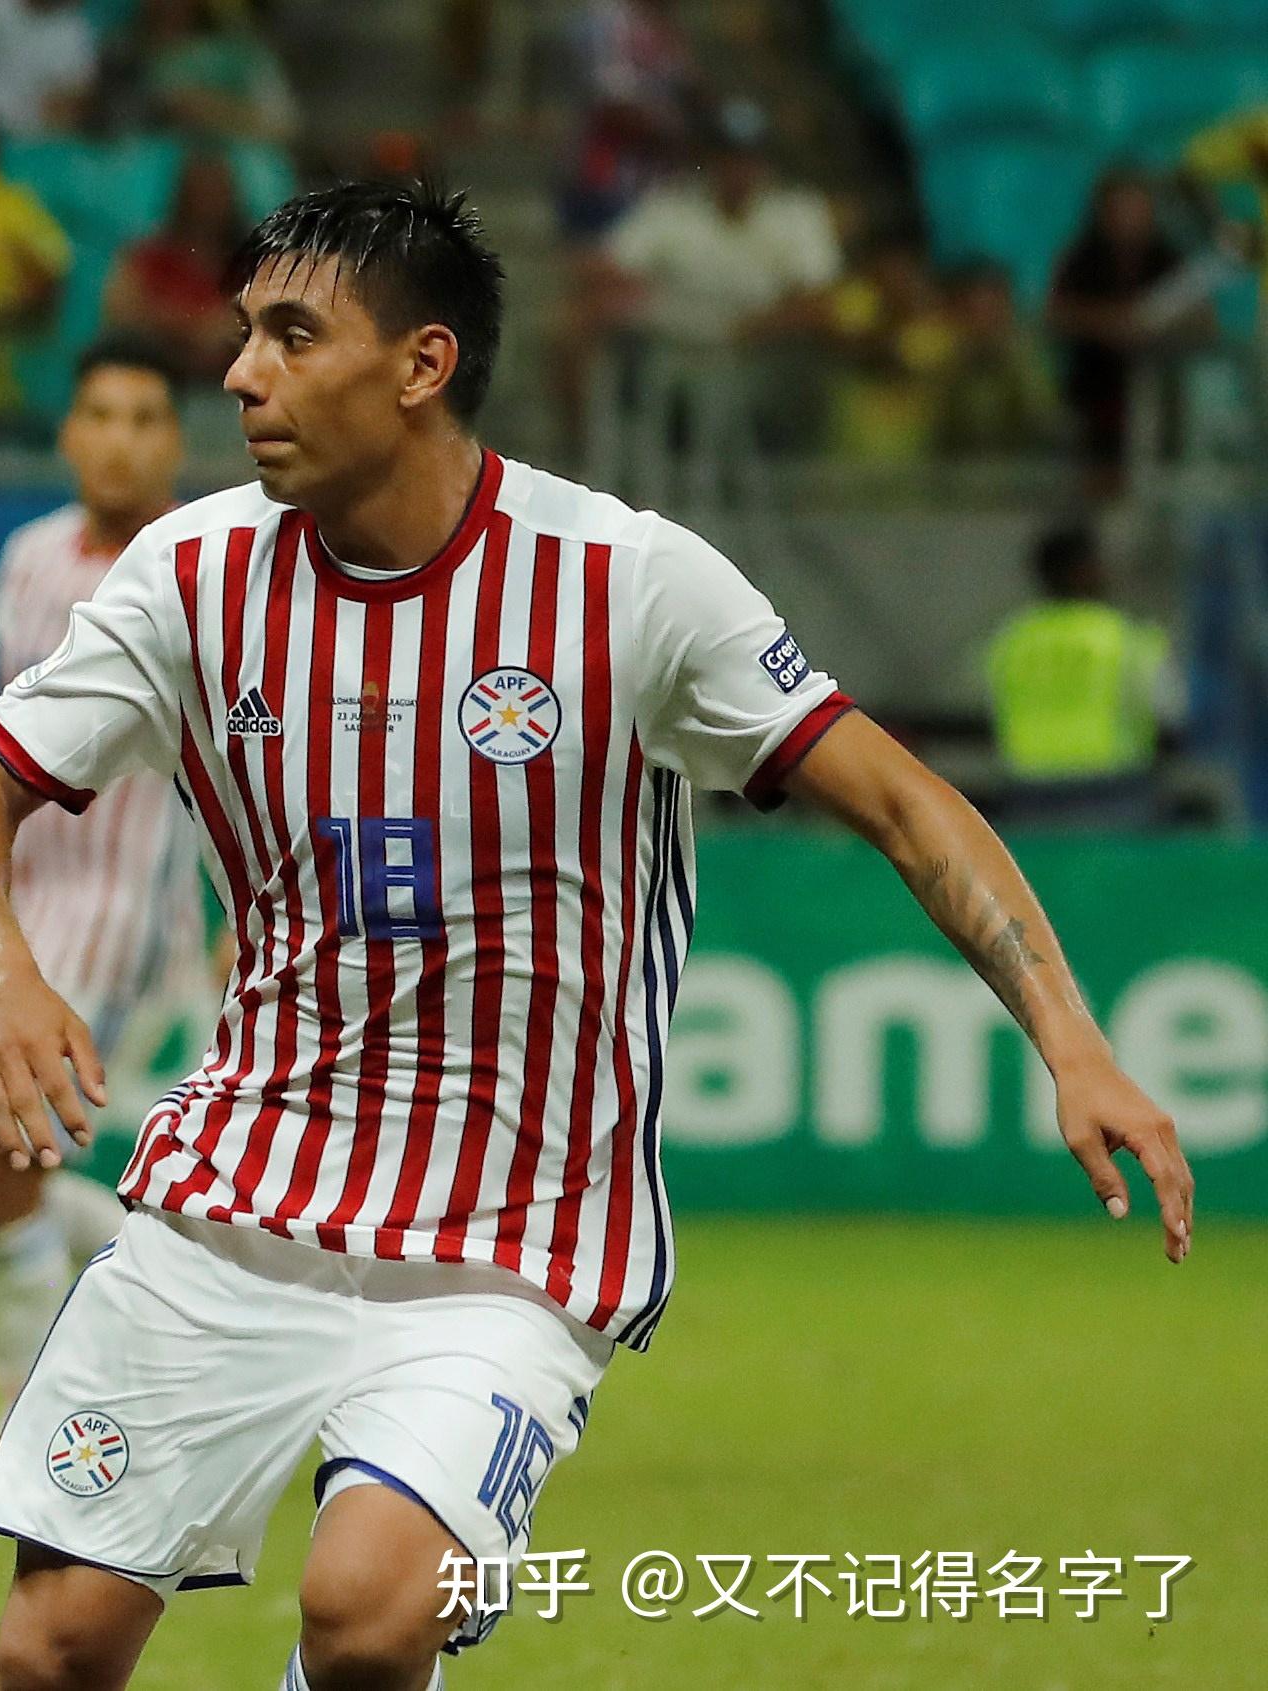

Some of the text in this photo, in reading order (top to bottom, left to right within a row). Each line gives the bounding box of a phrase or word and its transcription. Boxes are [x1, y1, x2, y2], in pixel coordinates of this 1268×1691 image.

[494, 676, 528, 690] APF
[227, 715, 279, 734] adidas
[485, 745, 532, 759] PARAGUAY
[316, 817, 440, 941] 18
[82, 1416, 111, 1435] APF
